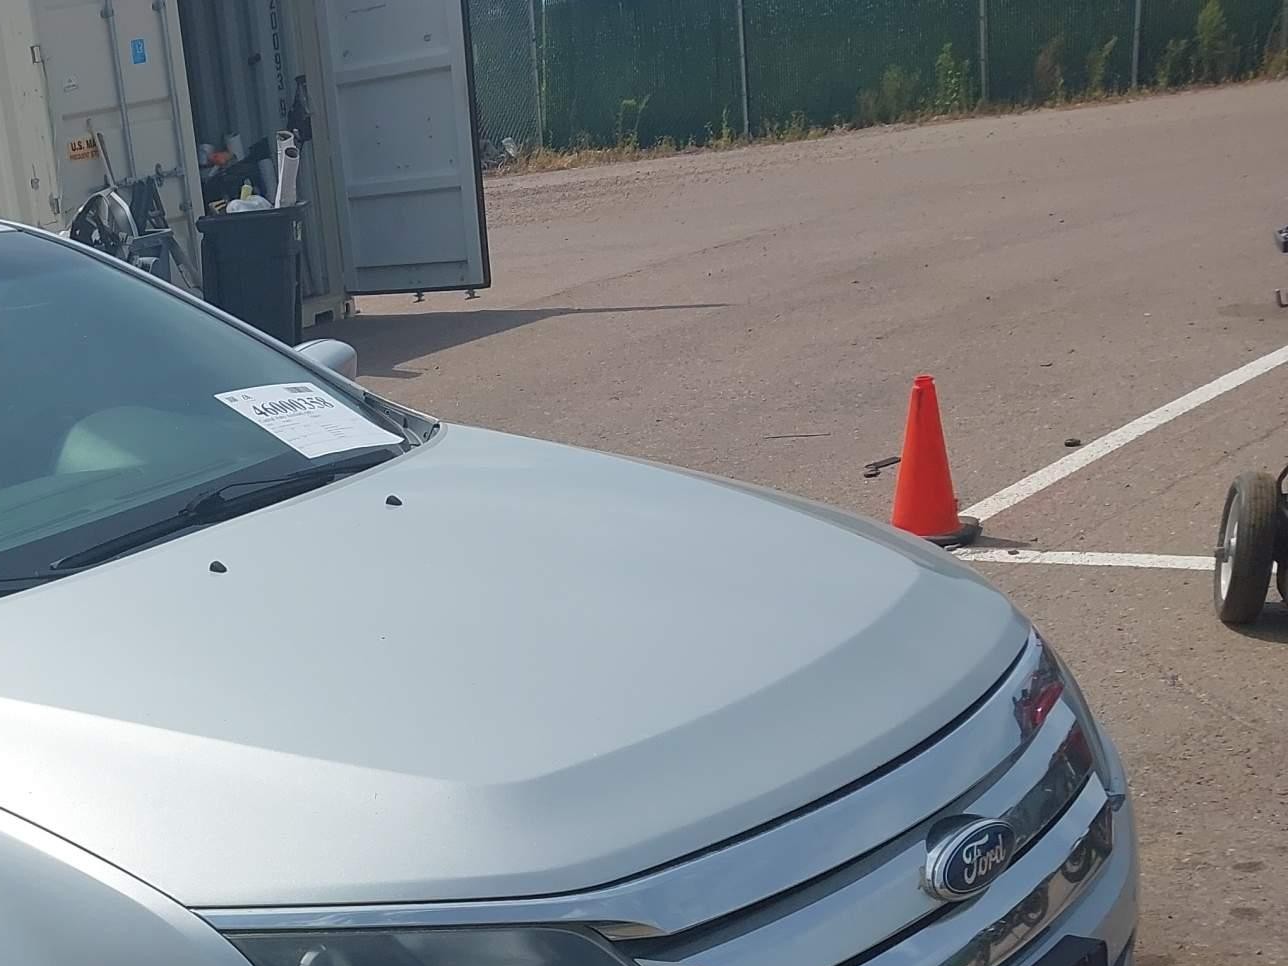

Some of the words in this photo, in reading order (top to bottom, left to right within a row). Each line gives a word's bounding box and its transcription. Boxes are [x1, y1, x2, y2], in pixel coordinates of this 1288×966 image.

[71, 140, 85, 152] U.S.
[252, 396, 335, 417] 46000358
[962, 833, 1006, 884] Ford
